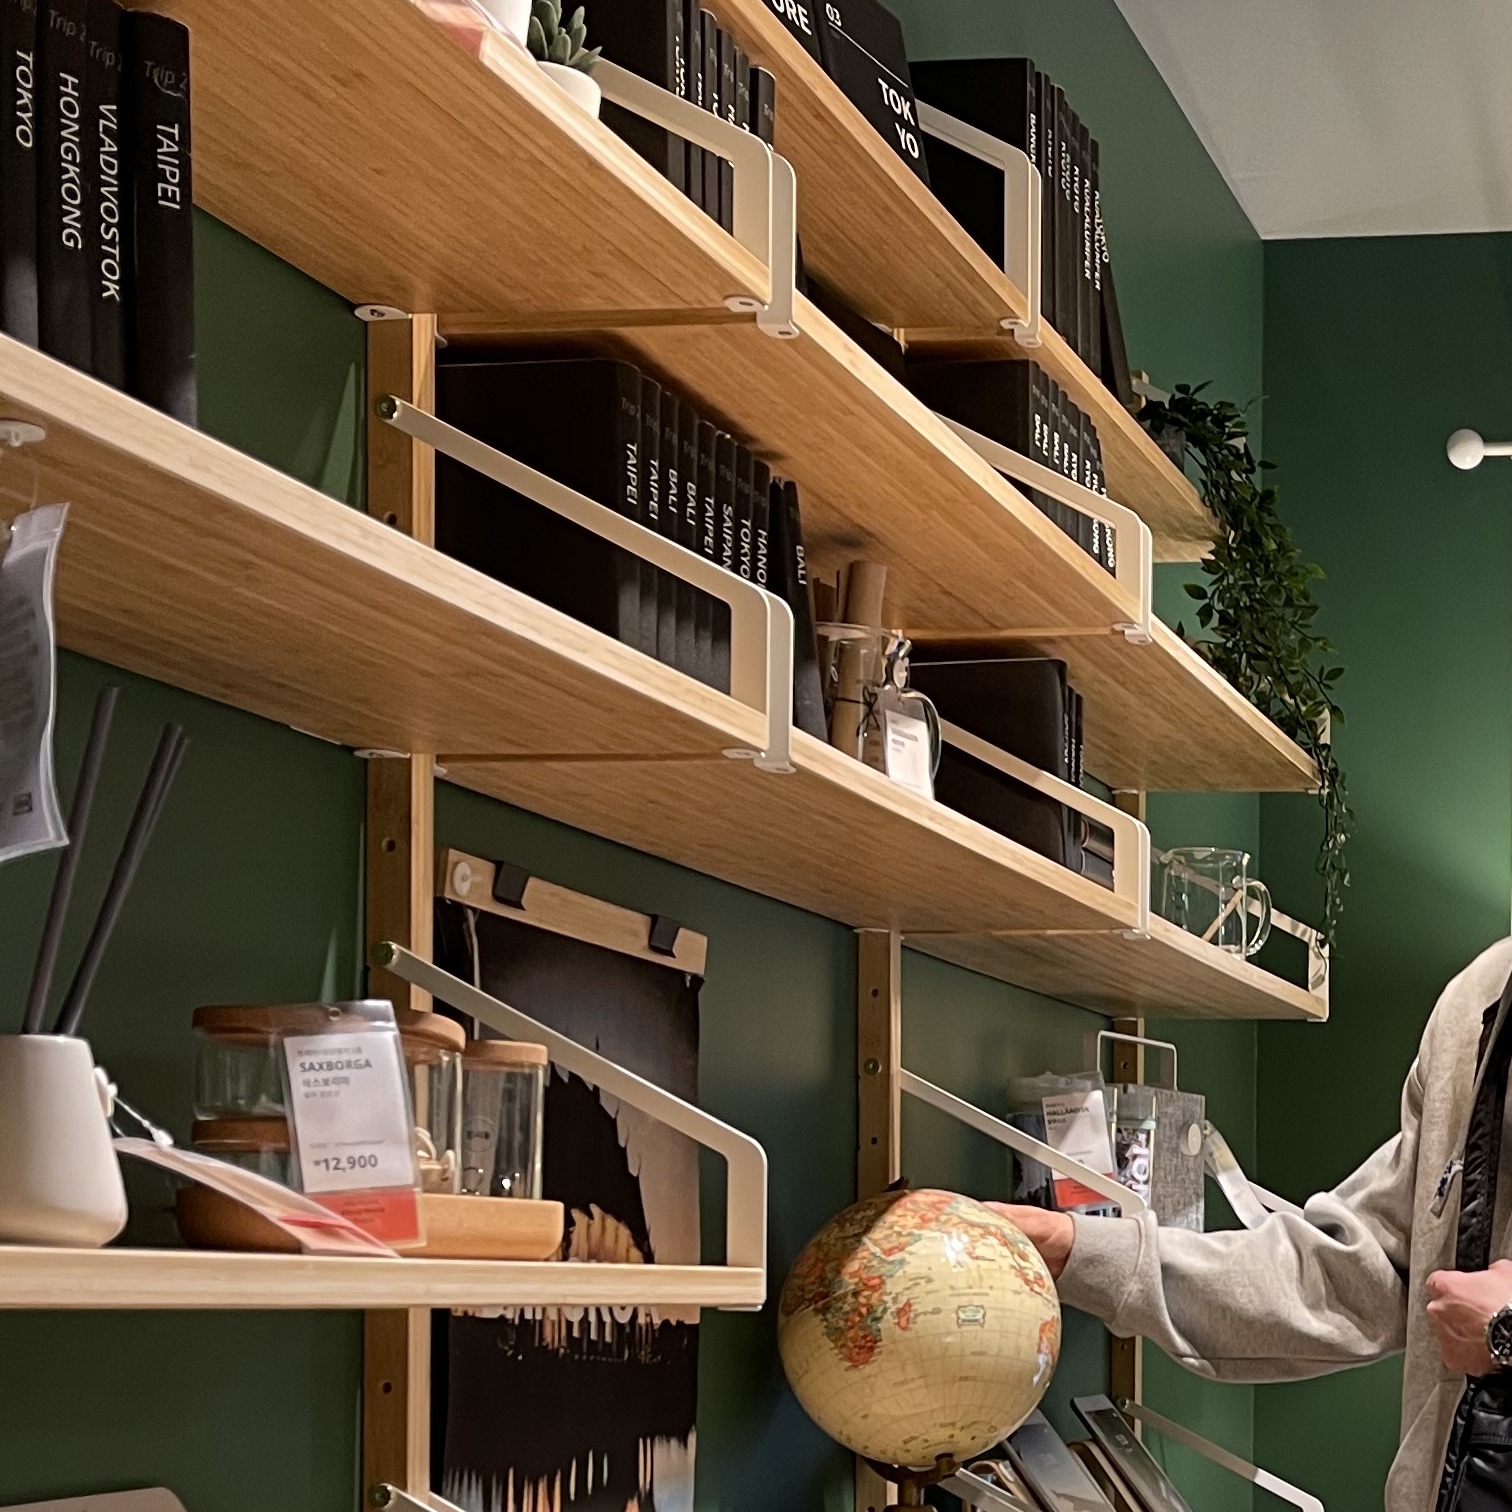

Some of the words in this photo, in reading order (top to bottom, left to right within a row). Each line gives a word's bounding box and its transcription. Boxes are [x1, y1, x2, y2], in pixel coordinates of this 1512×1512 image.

[825, 2, 842, 27] 03
[15, 50, 33, 149] TOKYO
[877, 77, 916, 126] TOK
[59, 72, 82, 250] HONGKONG
[156, 123, 181, 210] TAIPEI
[894, 122, 920, 159] YO
[98, 104, 120, 302] VLADIVOSTOK
[626, 443, 638, 505] TAIPEI
[649, 459, 659, 520] TAIPEI
[668, 468, 678, 514] BALI
[686, 481, 697, 526] BALI
[703, 496, 715, 555] TAIPEI
[722, 503, 733, 573] SAIPAN
[740, 518, 751, 580] TOKYO
[795, 544, 807, 586] BALI
[299, 1058, 373, 1073] SAXBORGA
